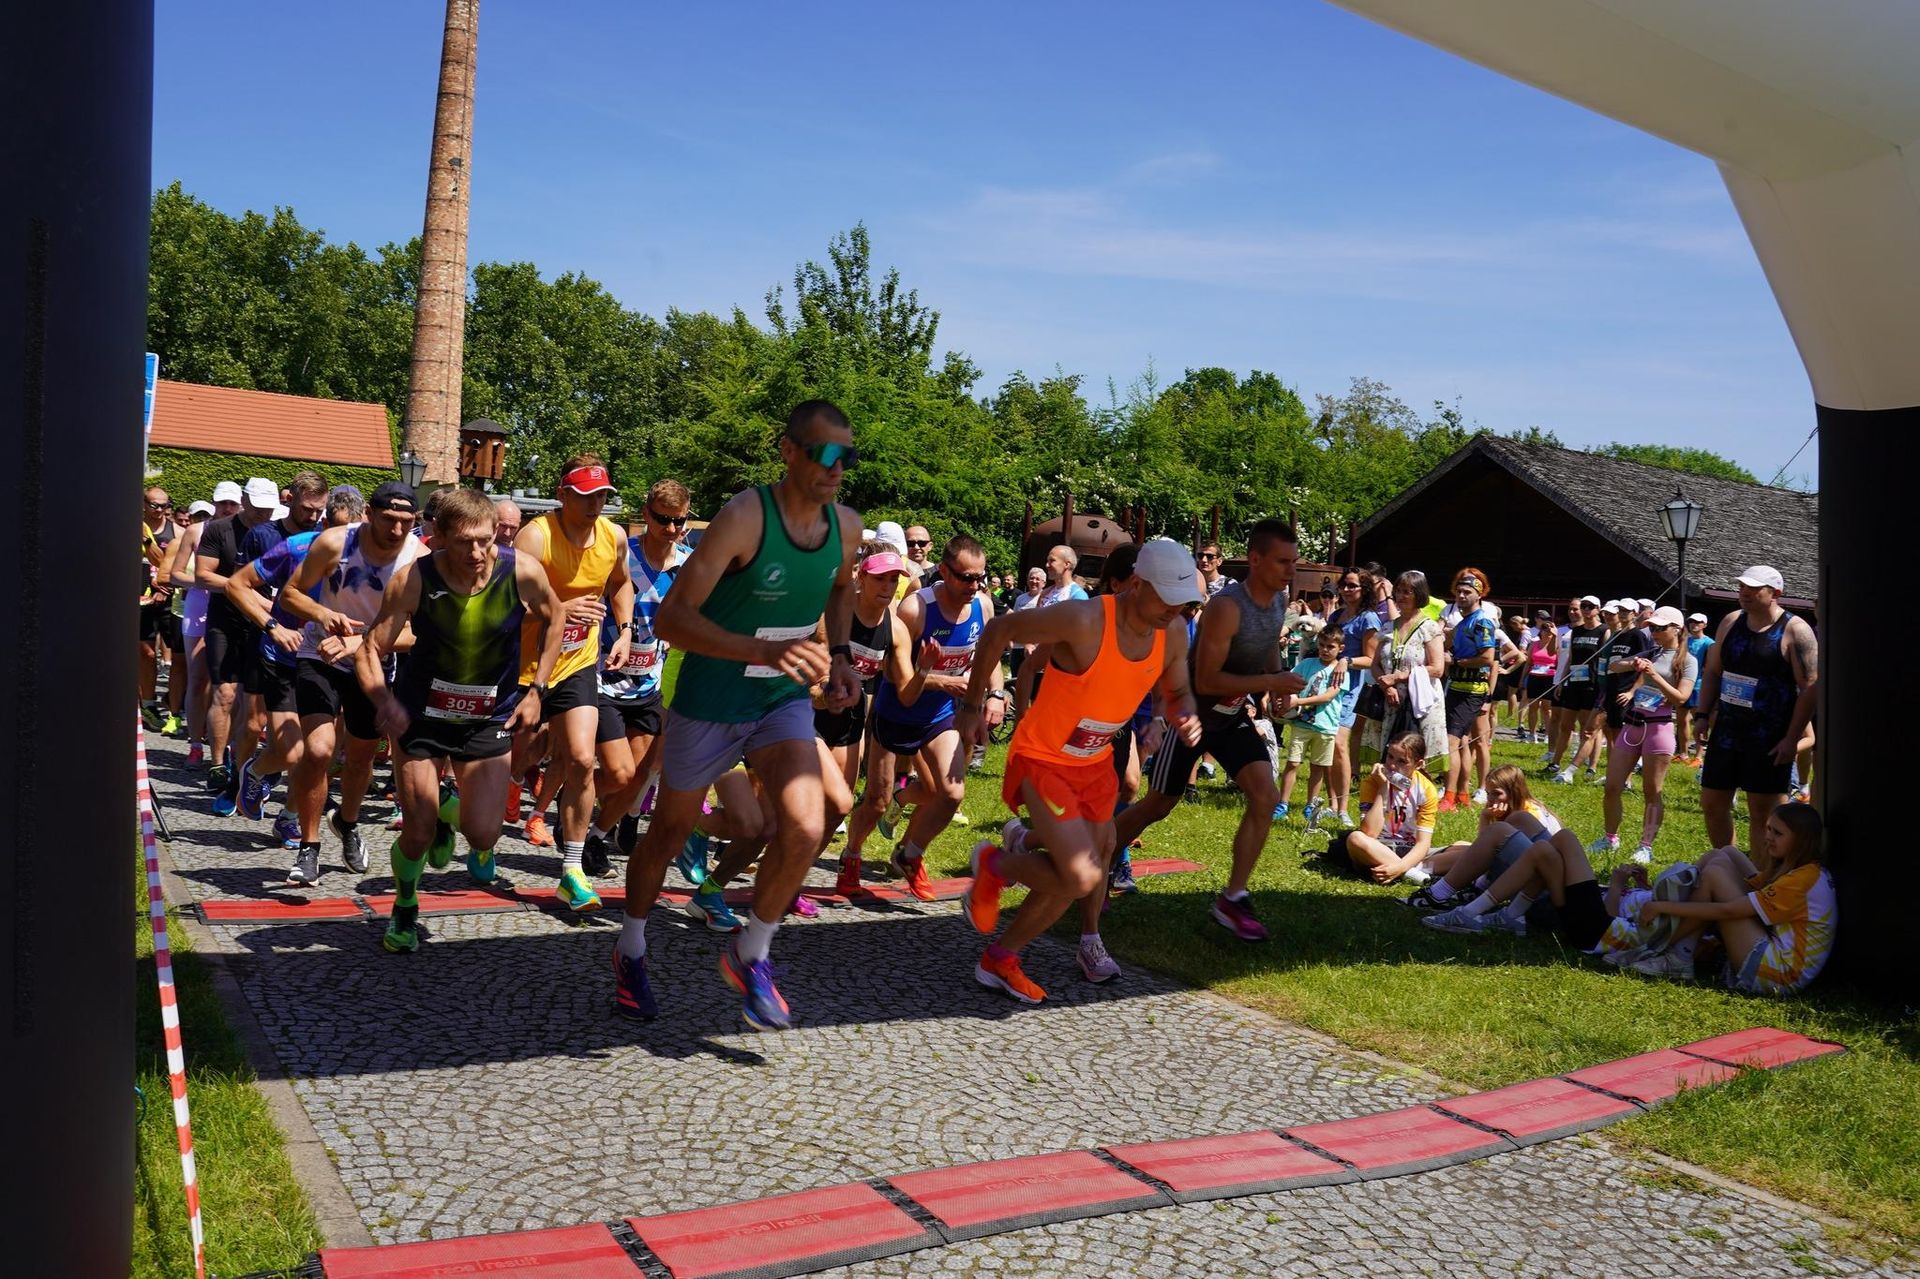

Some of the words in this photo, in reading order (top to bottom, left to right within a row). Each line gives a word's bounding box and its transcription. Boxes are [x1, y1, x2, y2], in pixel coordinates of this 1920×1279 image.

[628, 655, 650, 666] 389
[851, 659, 872, 673] 22
[943, 656, 965, 669] 426
[445, 698, 477, 711] 305
[1393, 806, 1407, 823] 15
